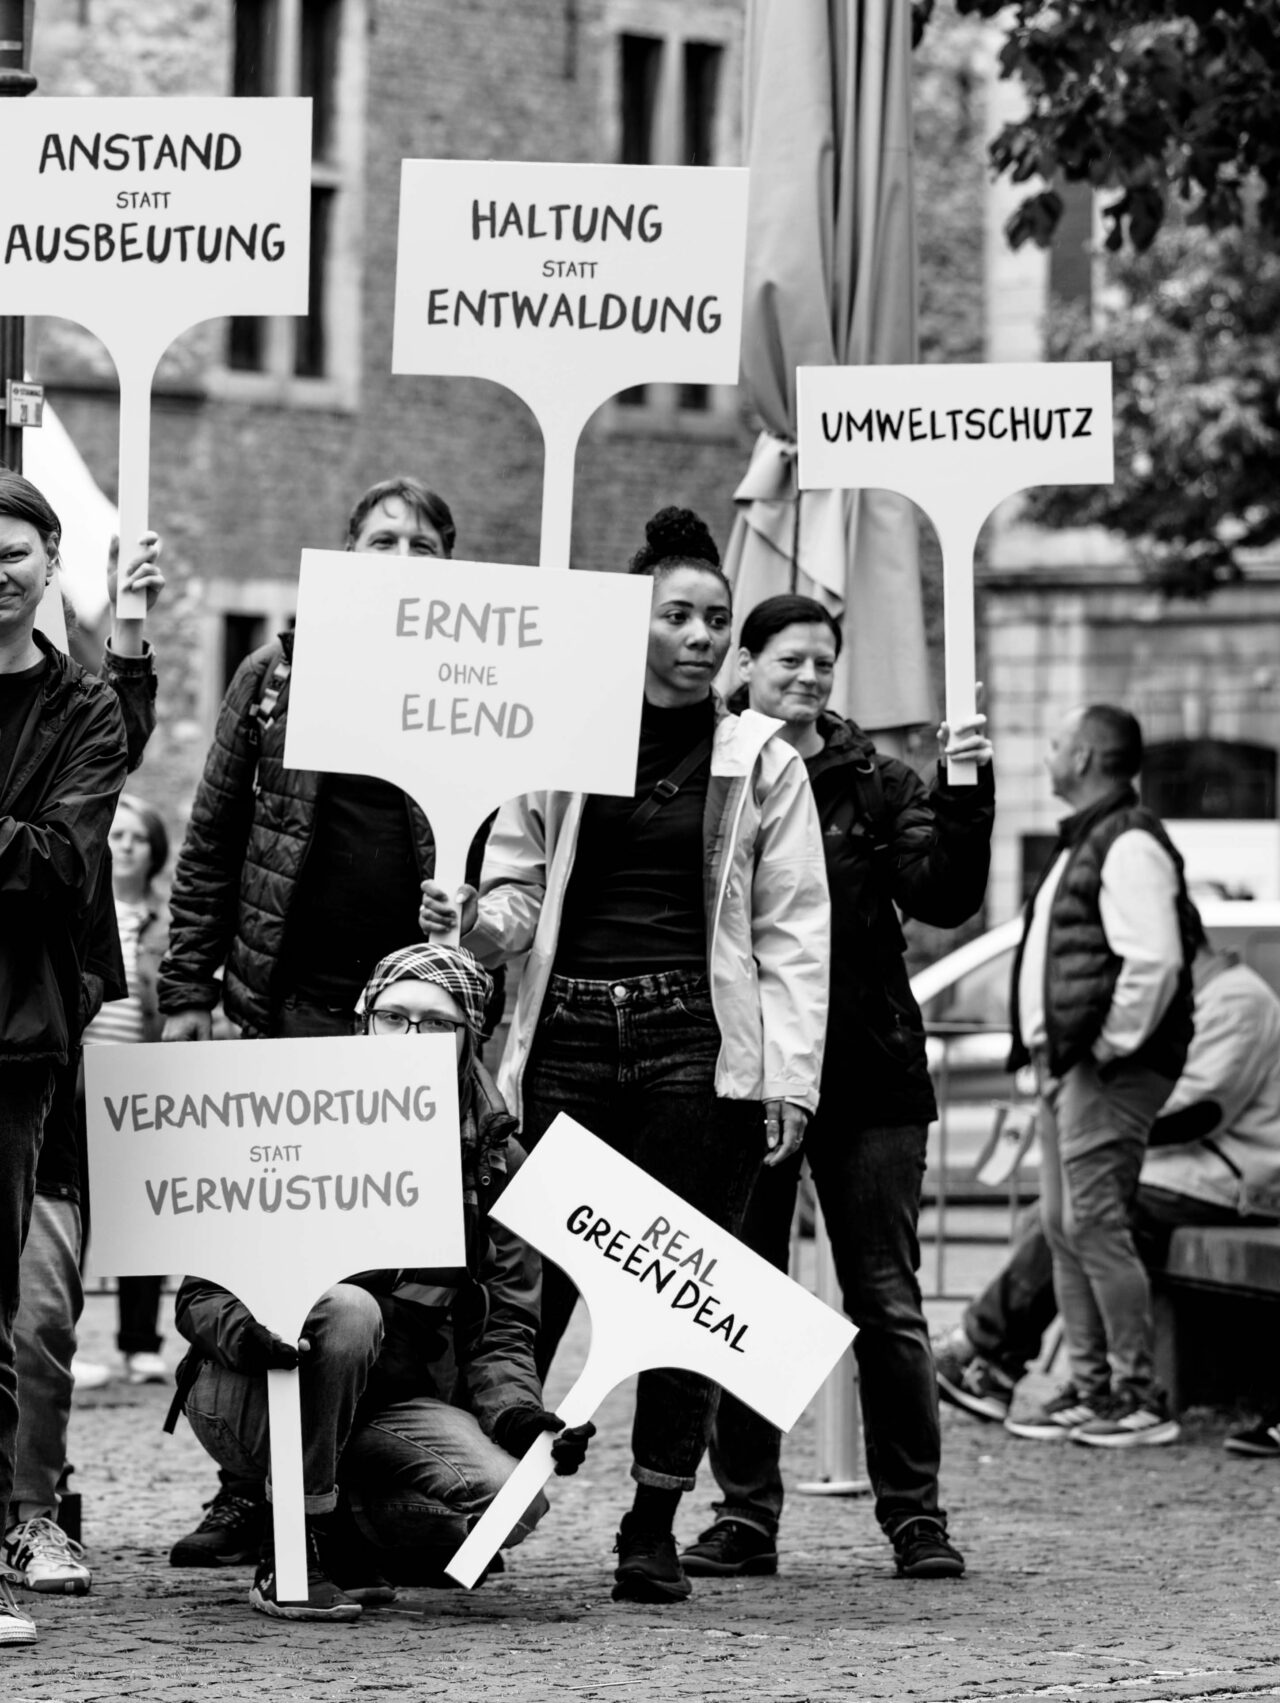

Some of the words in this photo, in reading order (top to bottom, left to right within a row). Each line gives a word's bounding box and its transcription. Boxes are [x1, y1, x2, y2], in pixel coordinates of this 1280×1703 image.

[39, 133, 242, 174] ANSTAND
[116, 191, 171, 209] STATT
[472, 199, 663, 243] HALTUNG
[4, 222, 286, 265] AUSBEUTUNG
[542, 260, 598, 279] STATT
[427, 288, 722, 334] ENTWALDUNG
[821, 406, 1093, 443] UMWELTSCHUTZ
[395, 597, 543, 649] ERNTE
[438, 662, 498, 686] OHNE
[401, 694, 534, 739] ELEND
[104, 1085, 436, 1132] VERANTWORTUNG
[249, 1145, 302, 1162] STATT
[145, 1168, 419, 1216] VERWÜSTUNG
[641, 1216, 718, 1287] REAL
[566, 1204, 677, 1294] GREEN
[670, 1279, 749, 1354] DEAL
